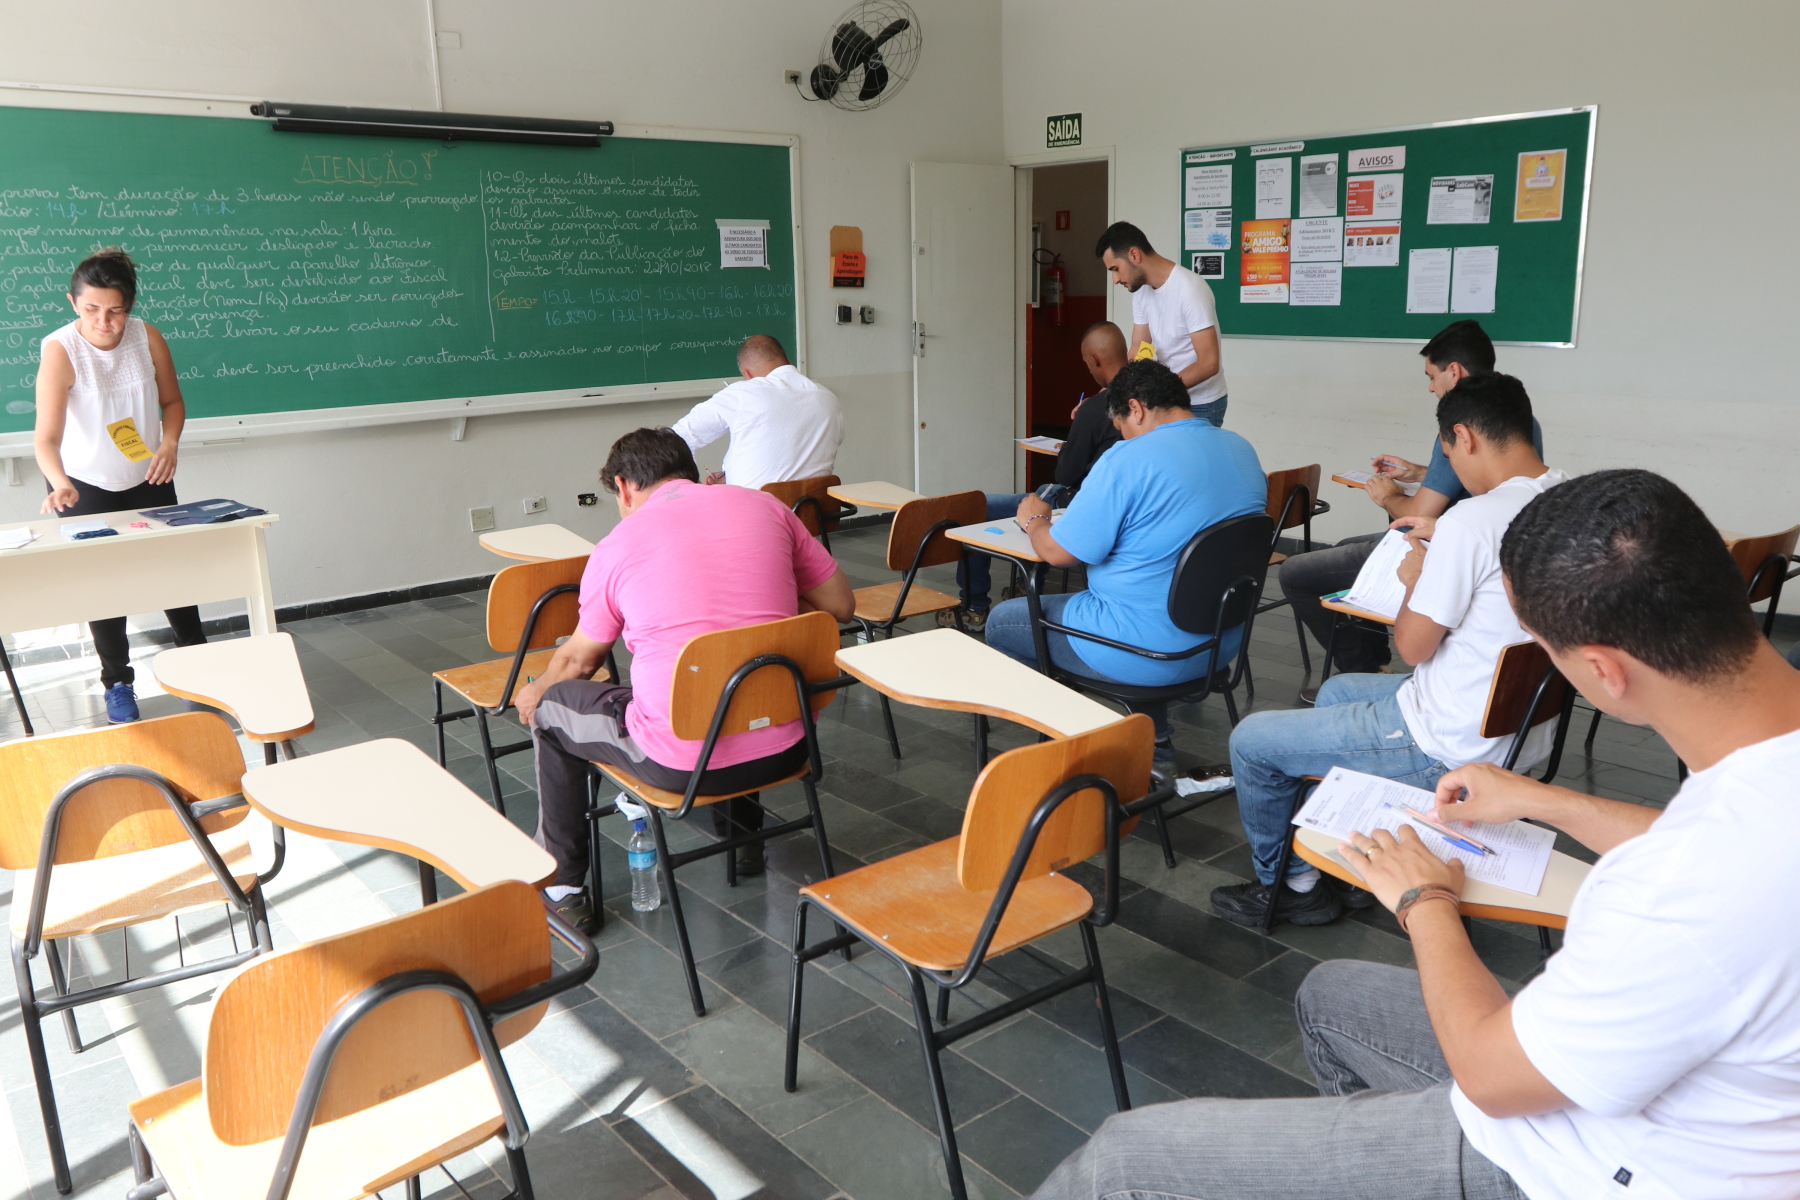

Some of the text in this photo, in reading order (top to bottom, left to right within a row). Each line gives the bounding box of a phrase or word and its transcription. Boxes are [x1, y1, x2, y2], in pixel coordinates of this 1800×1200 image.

[1048, 115, 1080, 141] SAÍDA
[1359, 155, 1394, 167] AVISOS
[540, 172, 570, 184] dois
[573, 171, 625, 186] últimos
[629, 175, 698, 187] candidatos
[0, 187, 59, 207] prova
[66, 184, 108, 199] tem
[114, 186, 198, 206] duração
[204, 189, 229, 201] de
[237, 188, 249, 202] 3
[254, 188, 301, 201] horas
[309, 191, 345, 202] não
[348, 192, 395, 203] sendo
[485, 182, 538, 195] deverão
[542, 186, 597, 195] assinar
[613, 188, 646, 196] verso
[649, 187, 667, 196] de
[670, 187, 701, 197] todos
[47, 201, 87, 218] 14h
[191, 202, 235, 216] 17h
[485, 194, 576, 209] os gabaritos
[532, 207, 562, 218] dois
[626, 207, 699, 219] candidatos
[42, 216, 124, 237] mínimo
[129, 224, 153, 237] de
[156, 223, 264, 243] permanência
[268, 225, 298, 236] na
[489, 218, 545, 230] deverão
[549, 219, 641, 236] acompanhar
[1244, 230, 1276, 238] PROGRAMA
[490, 231, 624, 246] mento do malote
[1252, 236, 1283, 247] AMIGO
[3, 240, 76, 256] celular
[86, 240, 134, 252] de
[140, 242, 247, 257] permanecer
[256, 238, 337, 257] desligado
[343, 242, 359, 250] e
[578, 249, 603, 260] da
[605, 245, 683, 261] Publicação
[686, 246, 706, 258] do
[8, 257, 75, 281] proibid
[168, 259, 190, 273] de
[197, 255, 279, 281] qualquer
[287, 253, 359, 277] aparelho
[493, 264, 552, 286] Gabarito
[20, 276, 70, 300] gaba
[136, 274, 185, 296] ficial
[196, 276, 235, 290] deve
[242, 274, 274, 288] ser
[281, 272, 362, 288] devolvido
[369, 275, 393, 285] ao
[400, 268, 448, 285] Fiscal
[6, 295, 64, 313] Erros
[134, 294, 201, 318] gitação
[292, 290, 351, 306] deverão
[355, 292, 387, 302] ser
[392, 288, 464, 308] corrigidos
[161, 323, 213, 340] oderá
[222, 319, 277, 338] levar
[303, 324, 339, 335] seu
[347, 318, 422, 332] caderno
[428, 313, 458, 327] de
[212, 362, 258, 378] deve
[265, 363, 299, 375] ser
[303, 354, 396, 381] preenchido
[402, 345, 499, 367] corretamente
[518, 346, 588, 360] assinado
[592, 345, 612, 355] no
[617, 342, 662, 358] campo
[669, 334, 751, 353] correspondent
[121, 438, 138, 447] FISCAL
